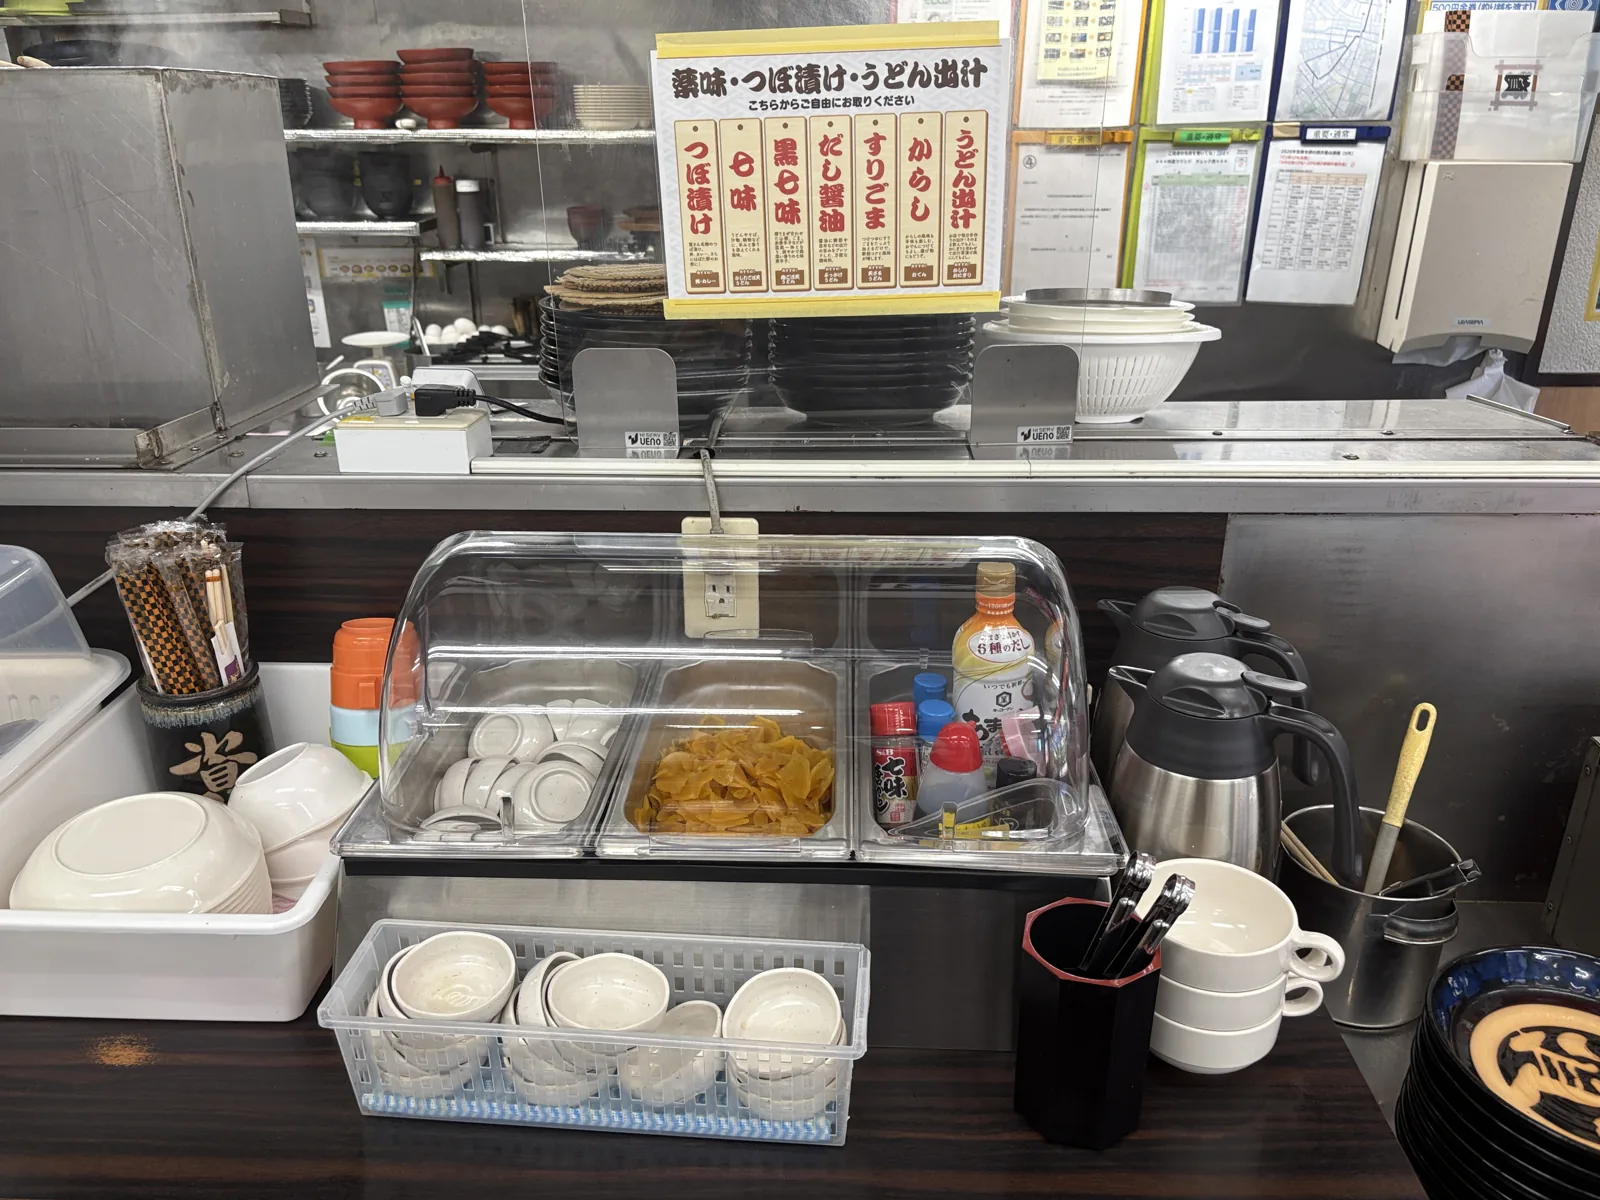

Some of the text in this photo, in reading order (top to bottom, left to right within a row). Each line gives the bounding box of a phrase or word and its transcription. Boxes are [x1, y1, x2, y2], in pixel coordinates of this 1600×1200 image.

[671, 57, 988, 98] 薬味・つぼ漬け・うどん出汁
[748, 96, 914, 111] こちらからご自由にお取りください
[684, 141, 712, 235] つぼ漬け
[730, 152, 757, 212] 七味
[774, 138, 801, 225] 黒七味
[818, 134, 845, 233] だし醤油
[863, 132, 889, 229] すりごま
[908, 137, 933, 222] からし
[950, 129, 979, 230] うどん出汁
[640, 437, 661, 445] UENO
[978, 638, 1030, 654] 6種のだし
[882, 756, 908, 799] 七味
